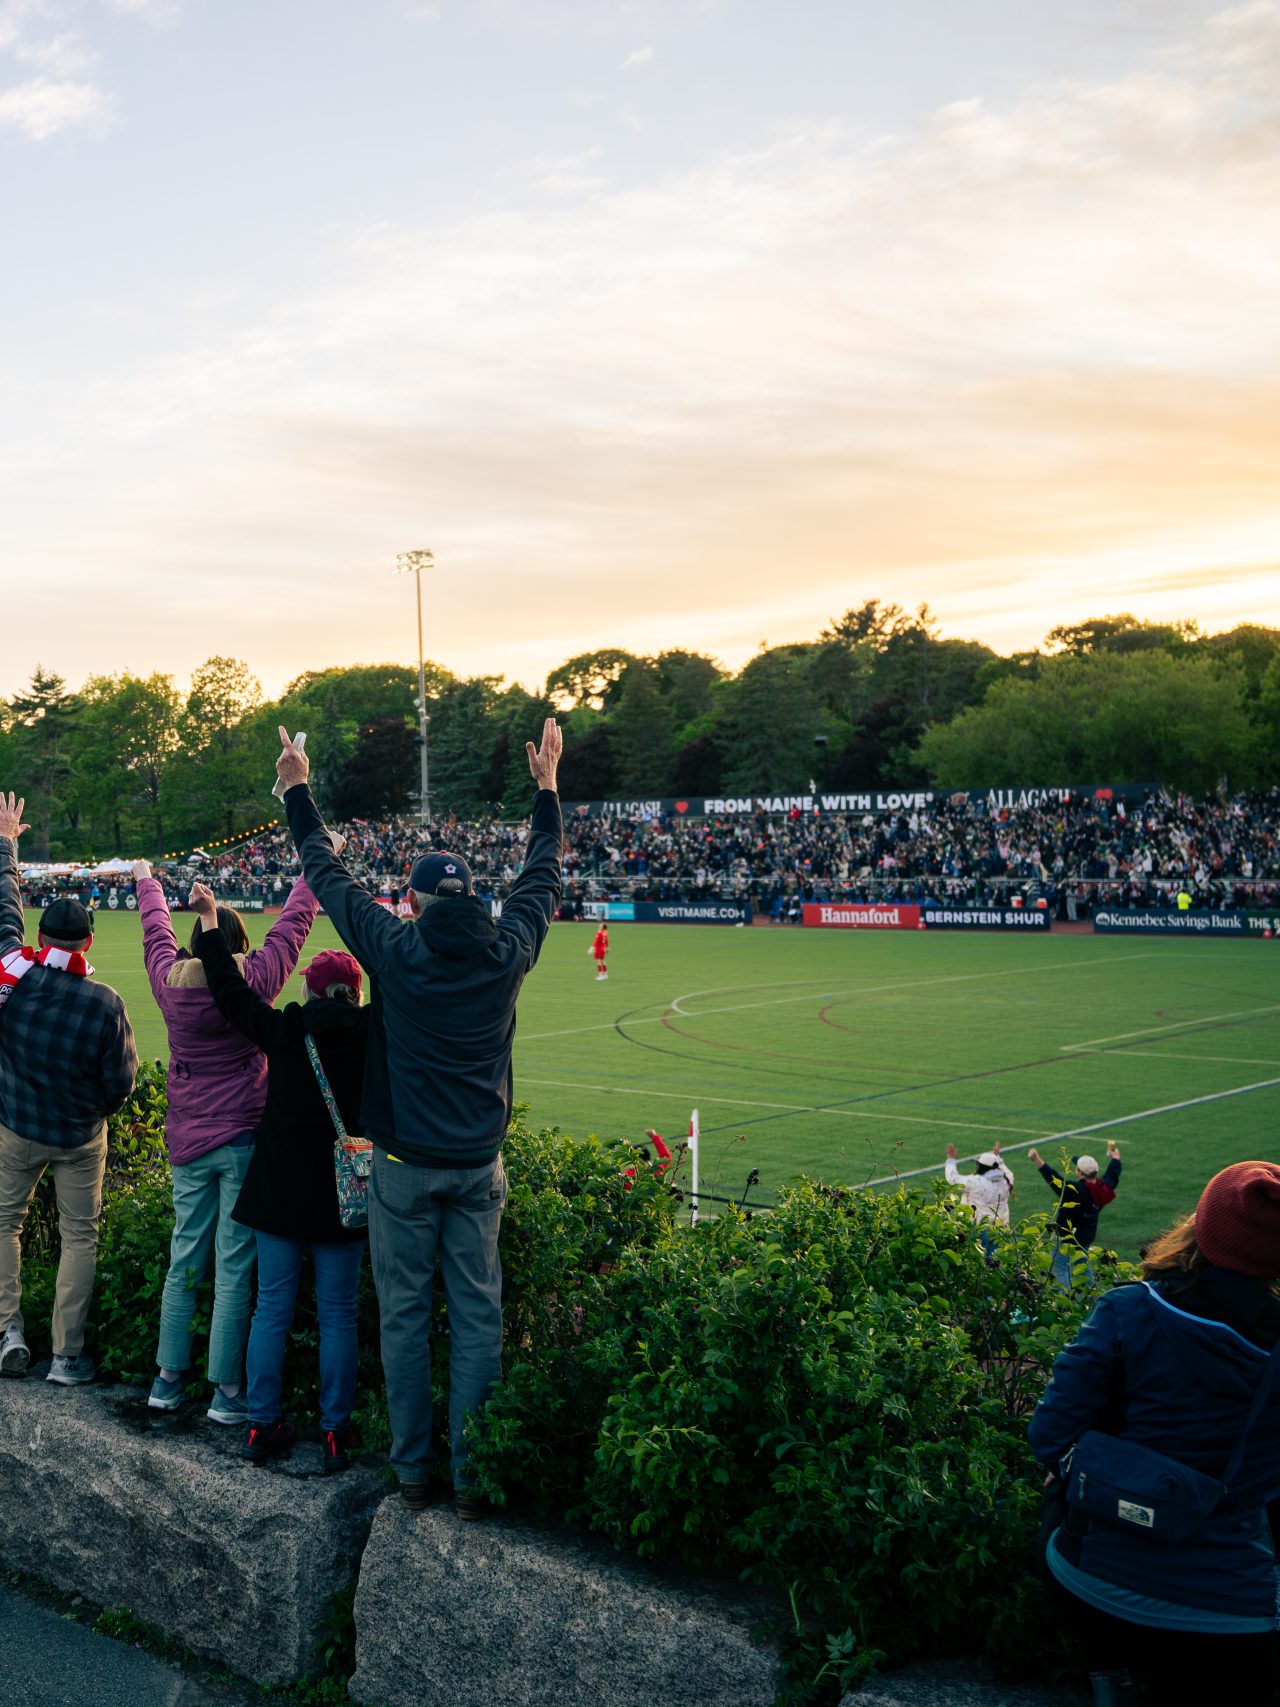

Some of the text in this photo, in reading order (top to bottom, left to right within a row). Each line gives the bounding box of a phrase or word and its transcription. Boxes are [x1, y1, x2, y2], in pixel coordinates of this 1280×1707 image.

[704, 799, 752, 814] FROM
[821, 795, 871, 811] WITH
[251, 899, 263, 909] PINE
[658, 906, 745, 919] VISITMAINE.COM
[821, 907, 900, 924] Hannaford
[925, 911, 1044, 925] BERNSTEIN SHUR
[1110, 913, 1241, 930] Kennebec Savings Bank
